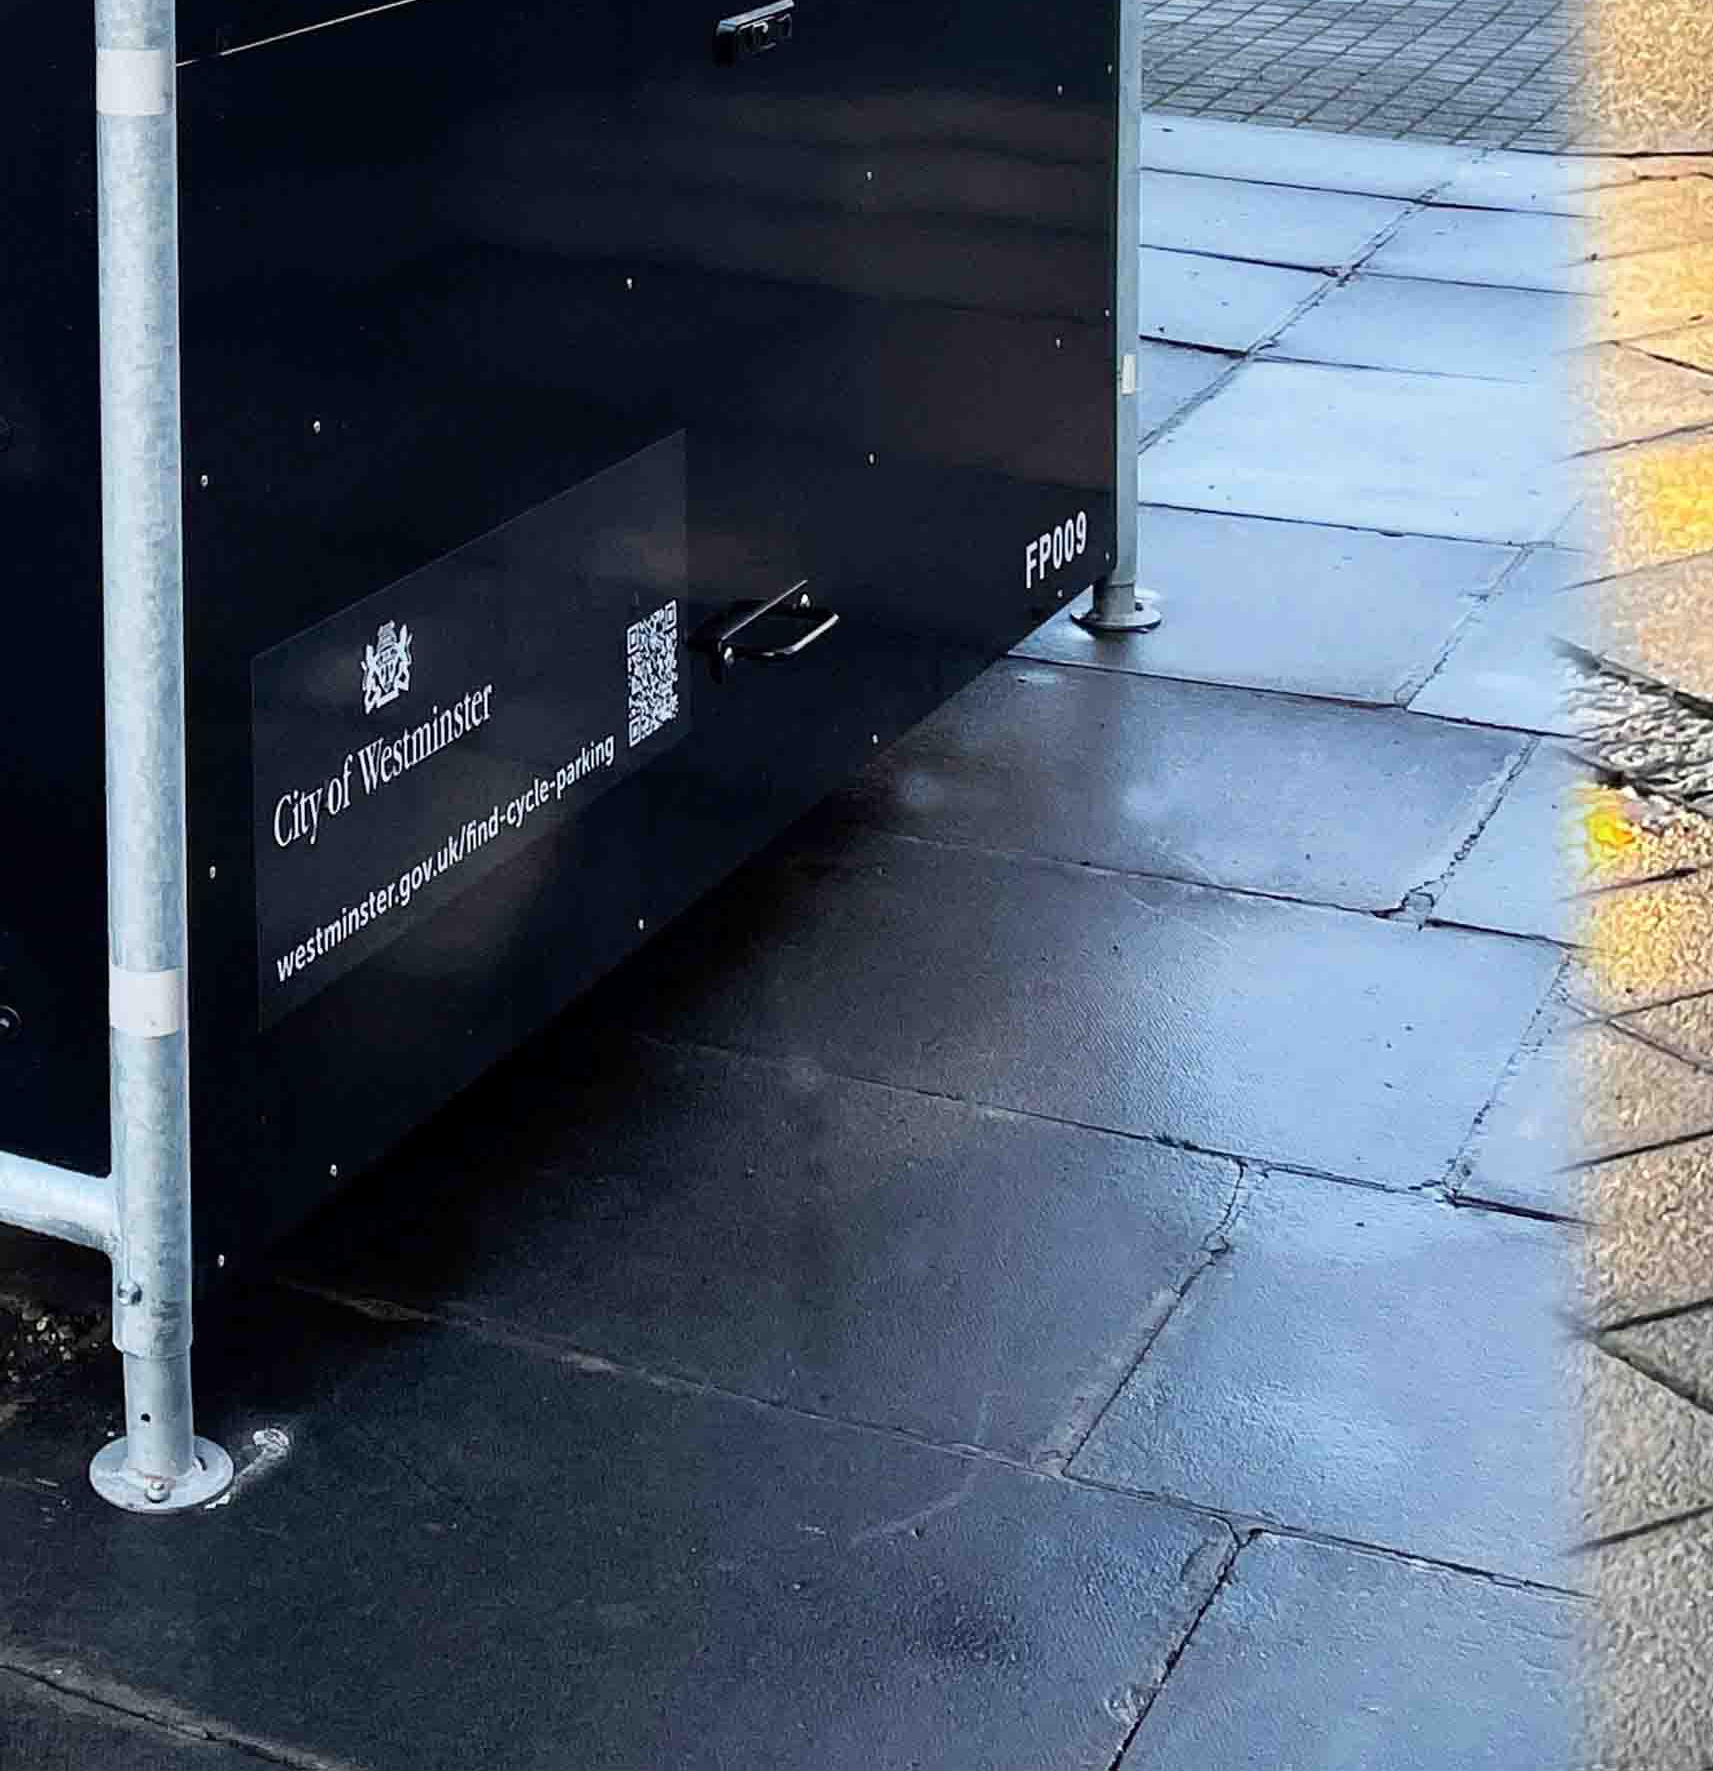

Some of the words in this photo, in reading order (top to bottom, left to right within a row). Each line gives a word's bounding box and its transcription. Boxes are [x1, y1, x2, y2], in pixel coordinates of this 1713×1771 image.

[1025, 510, 1087, 589] FP009
[273, 786, 322, 849] City
[326, 755, 356, 817] of
[357, 683, 493, 796] Westminster
[275, 733, 616, 983] westminster.gov.uk/find-cycle-parking
